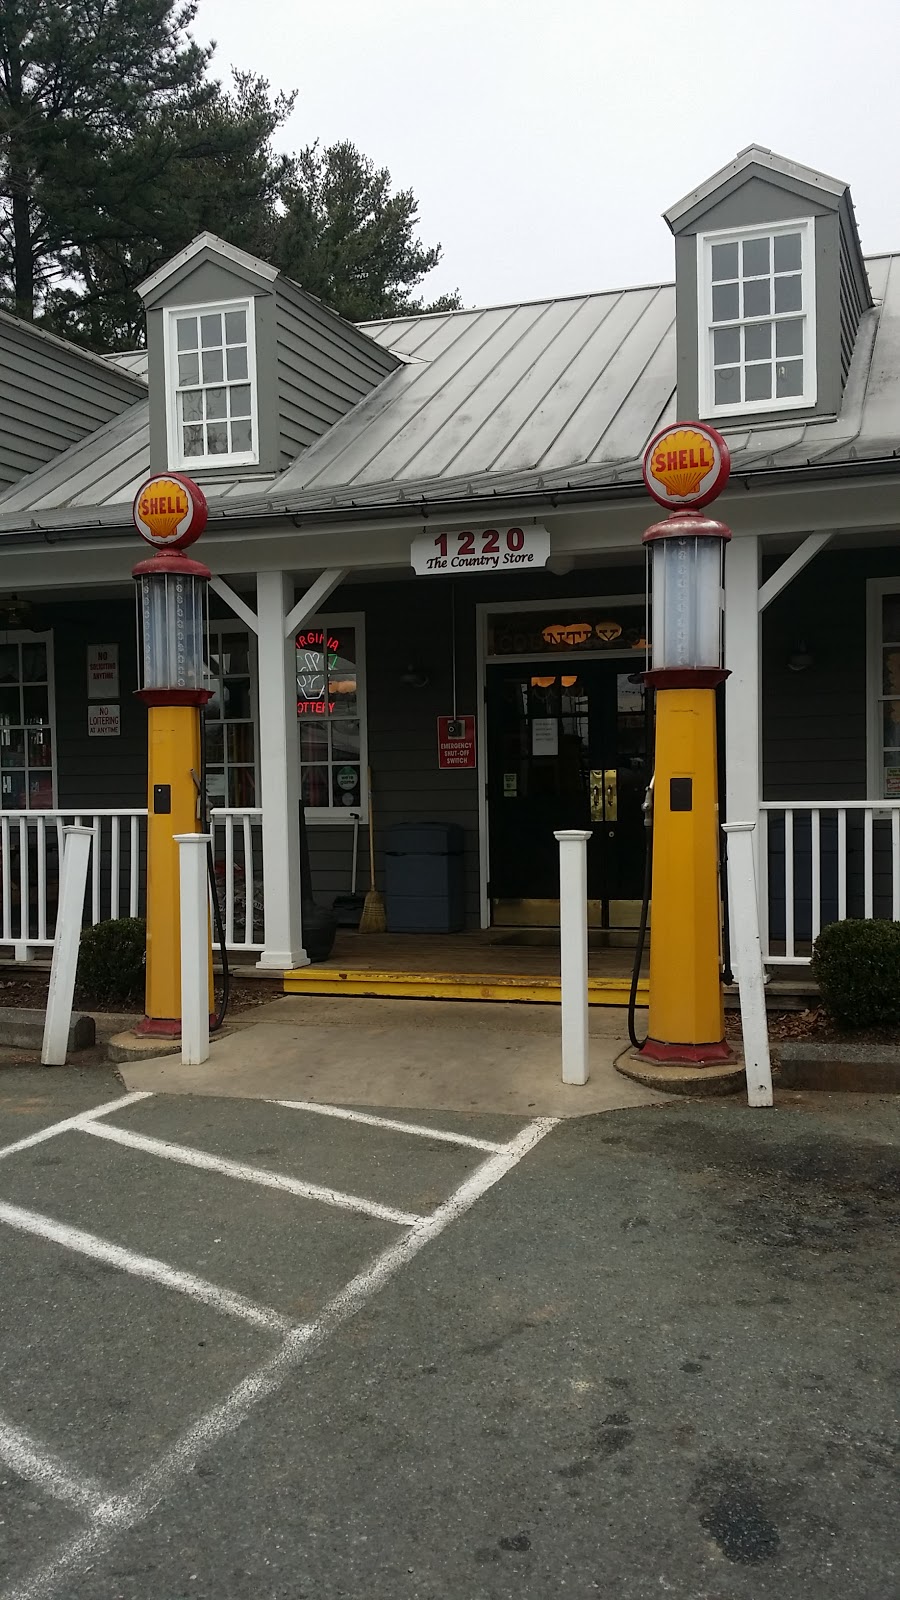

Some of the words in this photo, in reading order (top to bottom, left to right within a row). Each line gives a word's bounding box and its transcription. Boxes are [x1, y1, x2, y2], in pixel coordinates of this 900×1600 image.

[656, 448, 709, 472] SHELL
[141, 497, 184, 515] SHELL
[434, 527, 525, 557] 1220
[426, 557, 448, 569] The
[450, 555, 500, 569] Country
[502, 552, 534, 564] Store
[295, 632, 339, 652] IRGINIA
[97, 651, 108, 661] NO
[99, 707, 109, 716] NO
[89, 716, 119, 726] LOITERING
